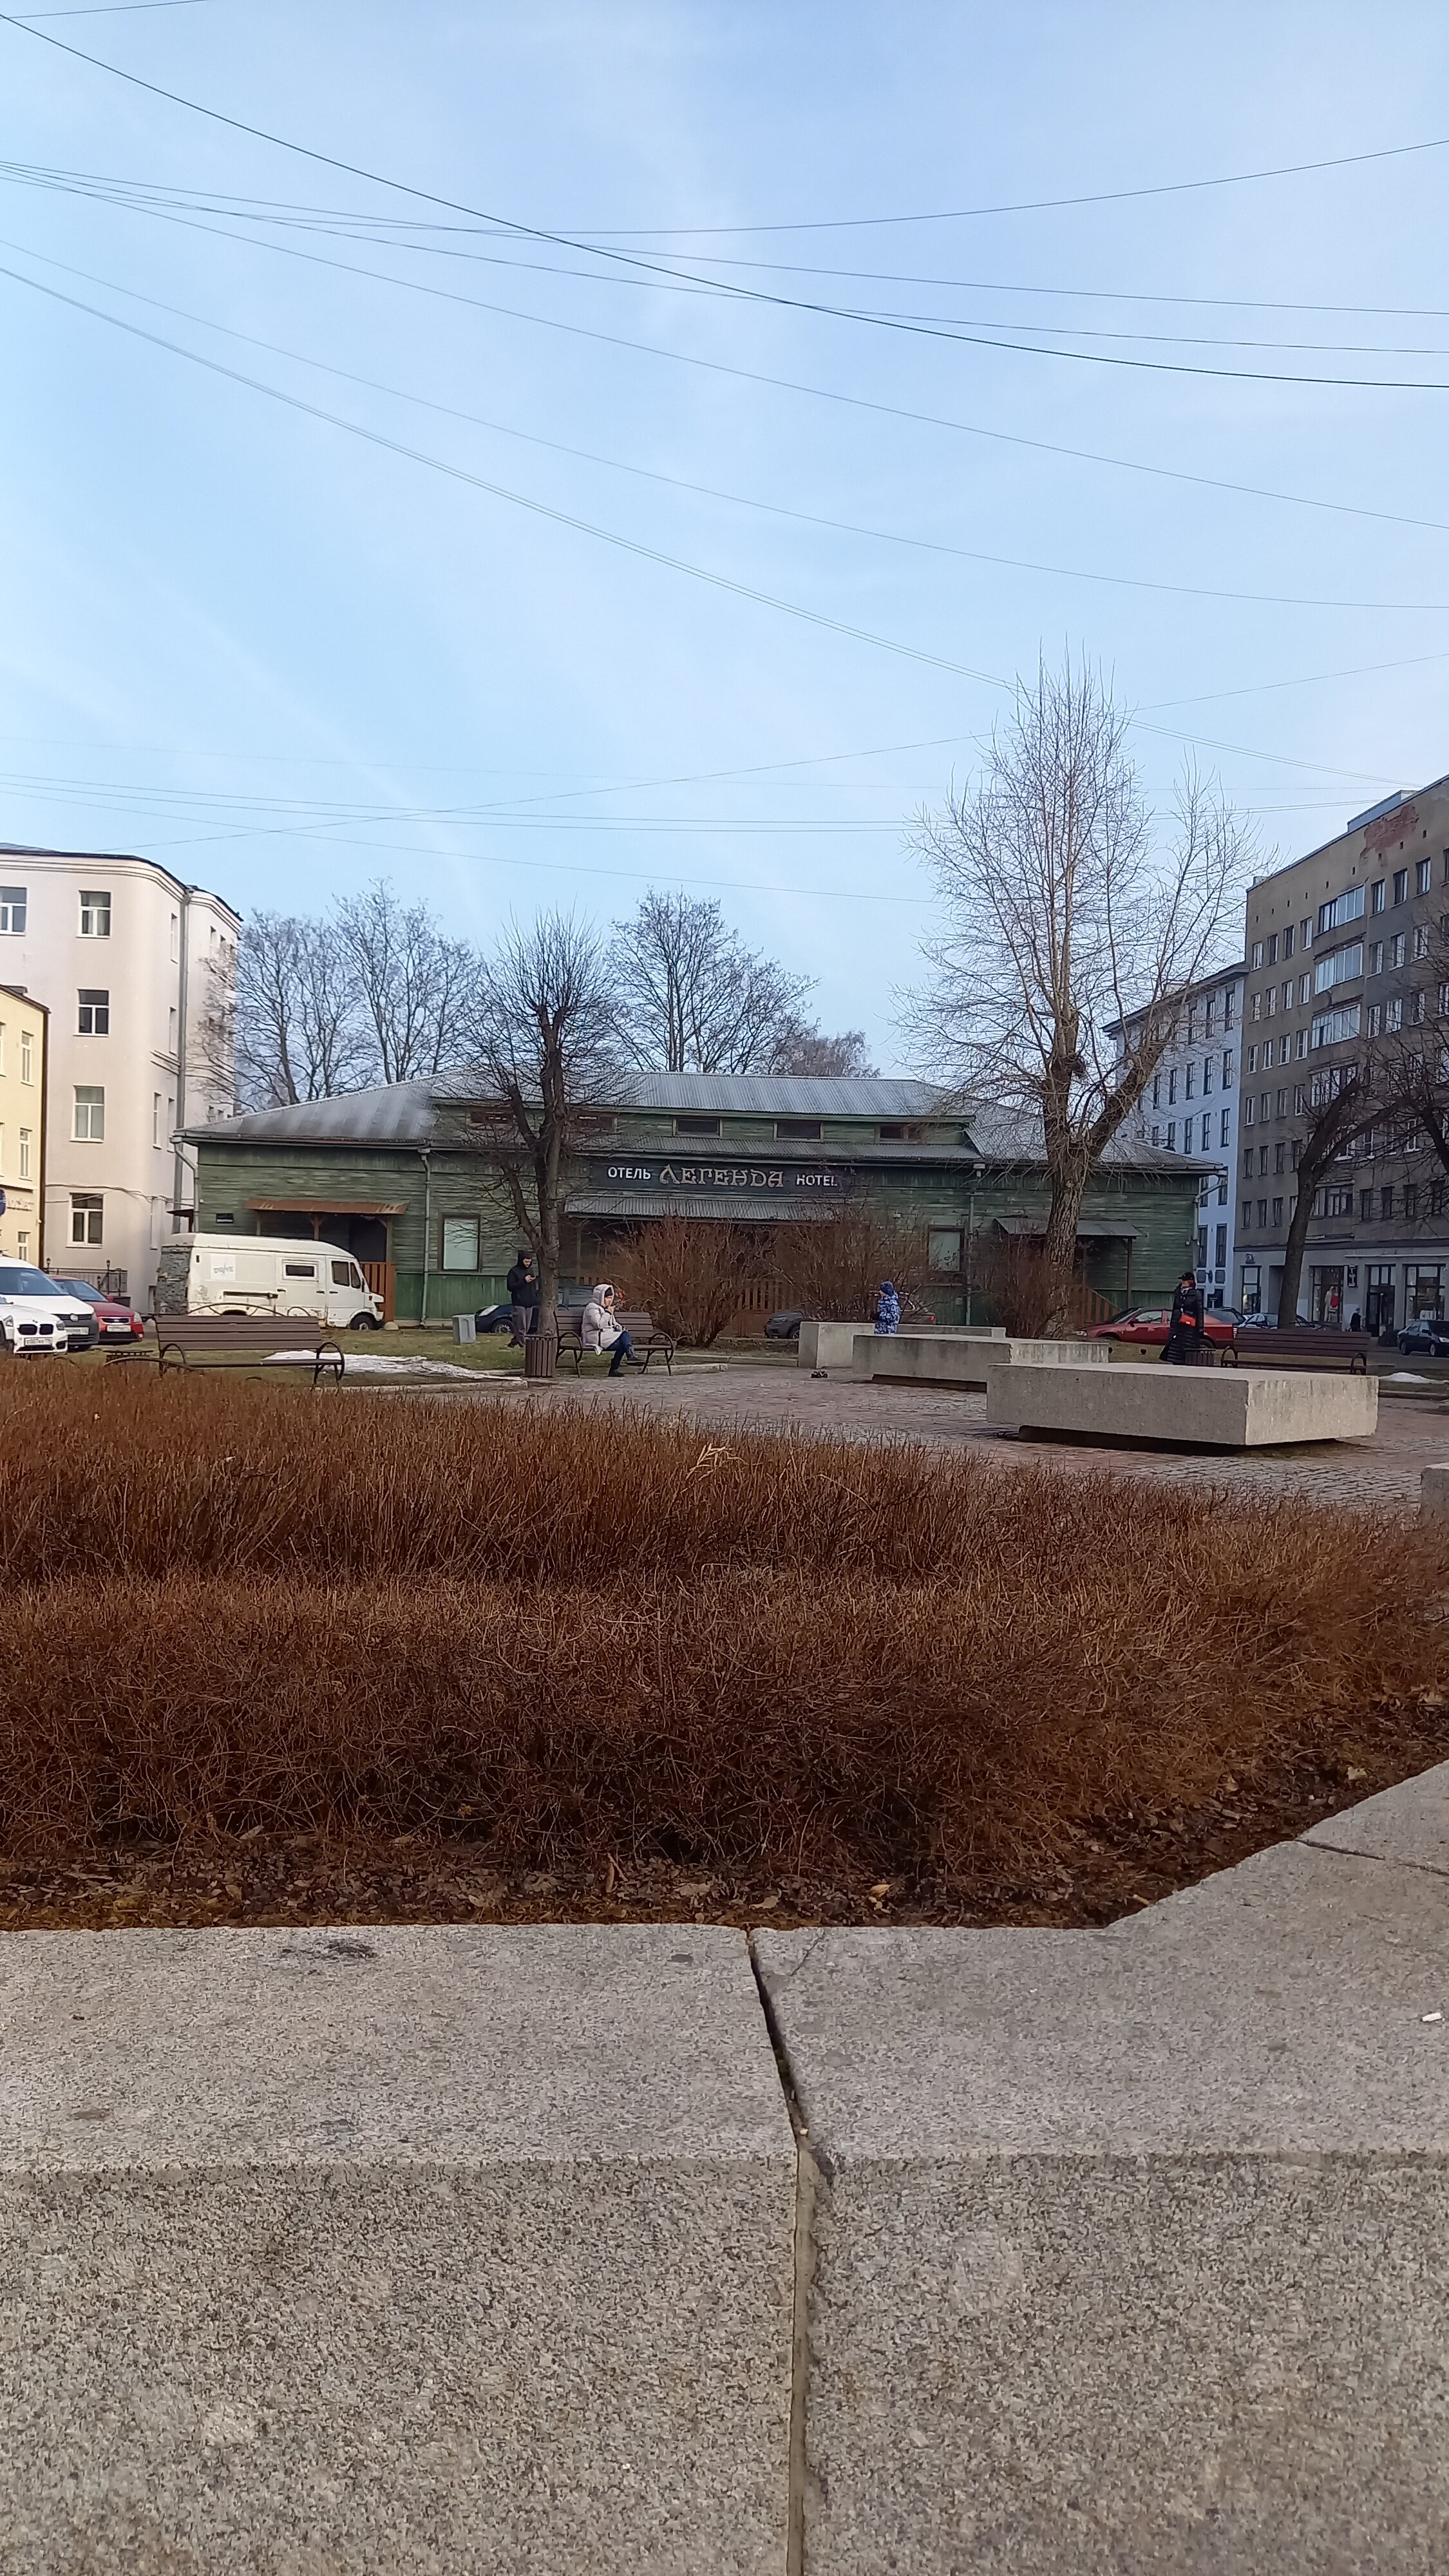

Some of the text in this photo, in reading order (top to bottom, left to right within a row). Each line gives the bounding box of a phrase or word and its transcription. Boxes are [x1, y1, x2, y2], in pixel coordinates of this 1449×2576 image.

[607, 1164, 837, 1188] ОТЕЛЬ ЛЕГЕНДА HOTEL
